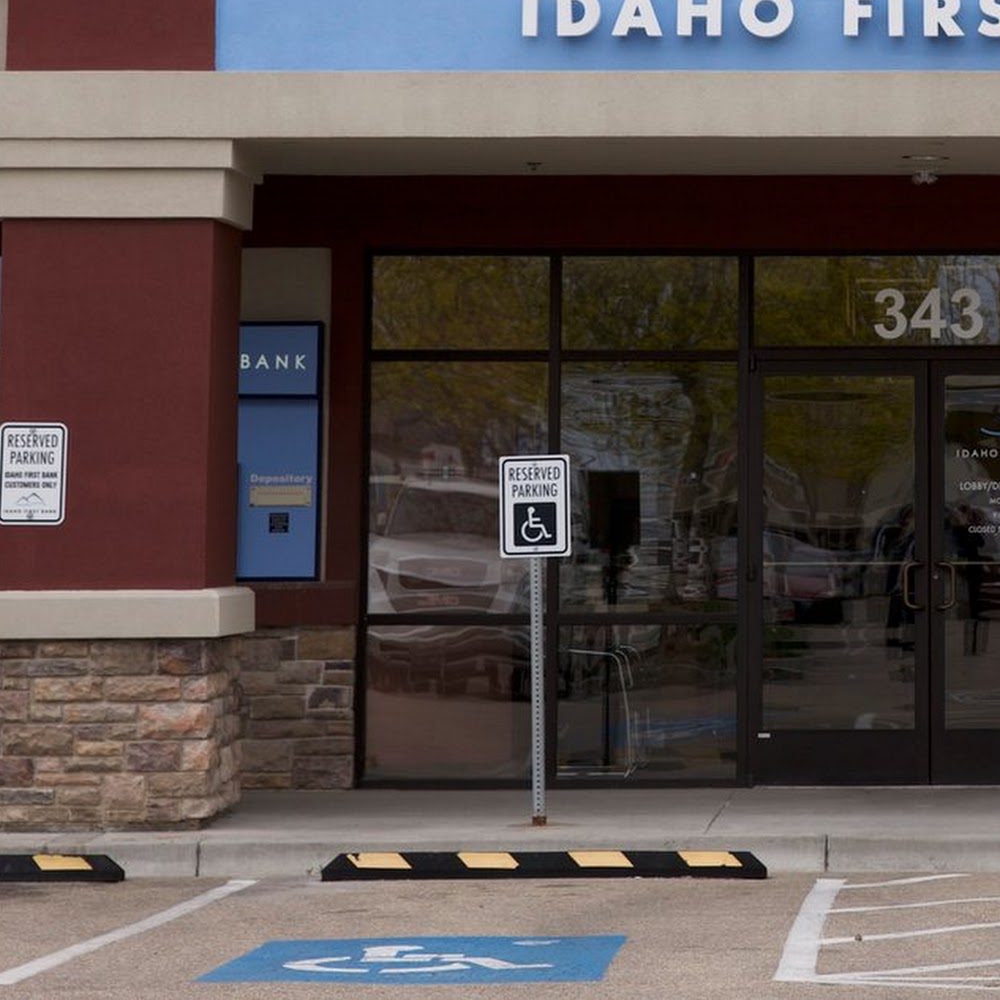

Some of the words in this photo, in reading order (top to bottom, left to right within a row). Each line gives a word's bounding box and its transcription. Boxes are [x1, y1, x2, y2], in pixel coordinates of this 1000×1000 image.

[874, 288, 984, 339] 343
[239, 354, 307, 370] BANK
[7, 433, 59, 448] RESERVED
[10, 451, 55, 465] PARKING
[956, 449, 999, 458] IDAHO
[508, 466, 560, 481] RESERVED
[512, 483, 558, 497] PARKING
